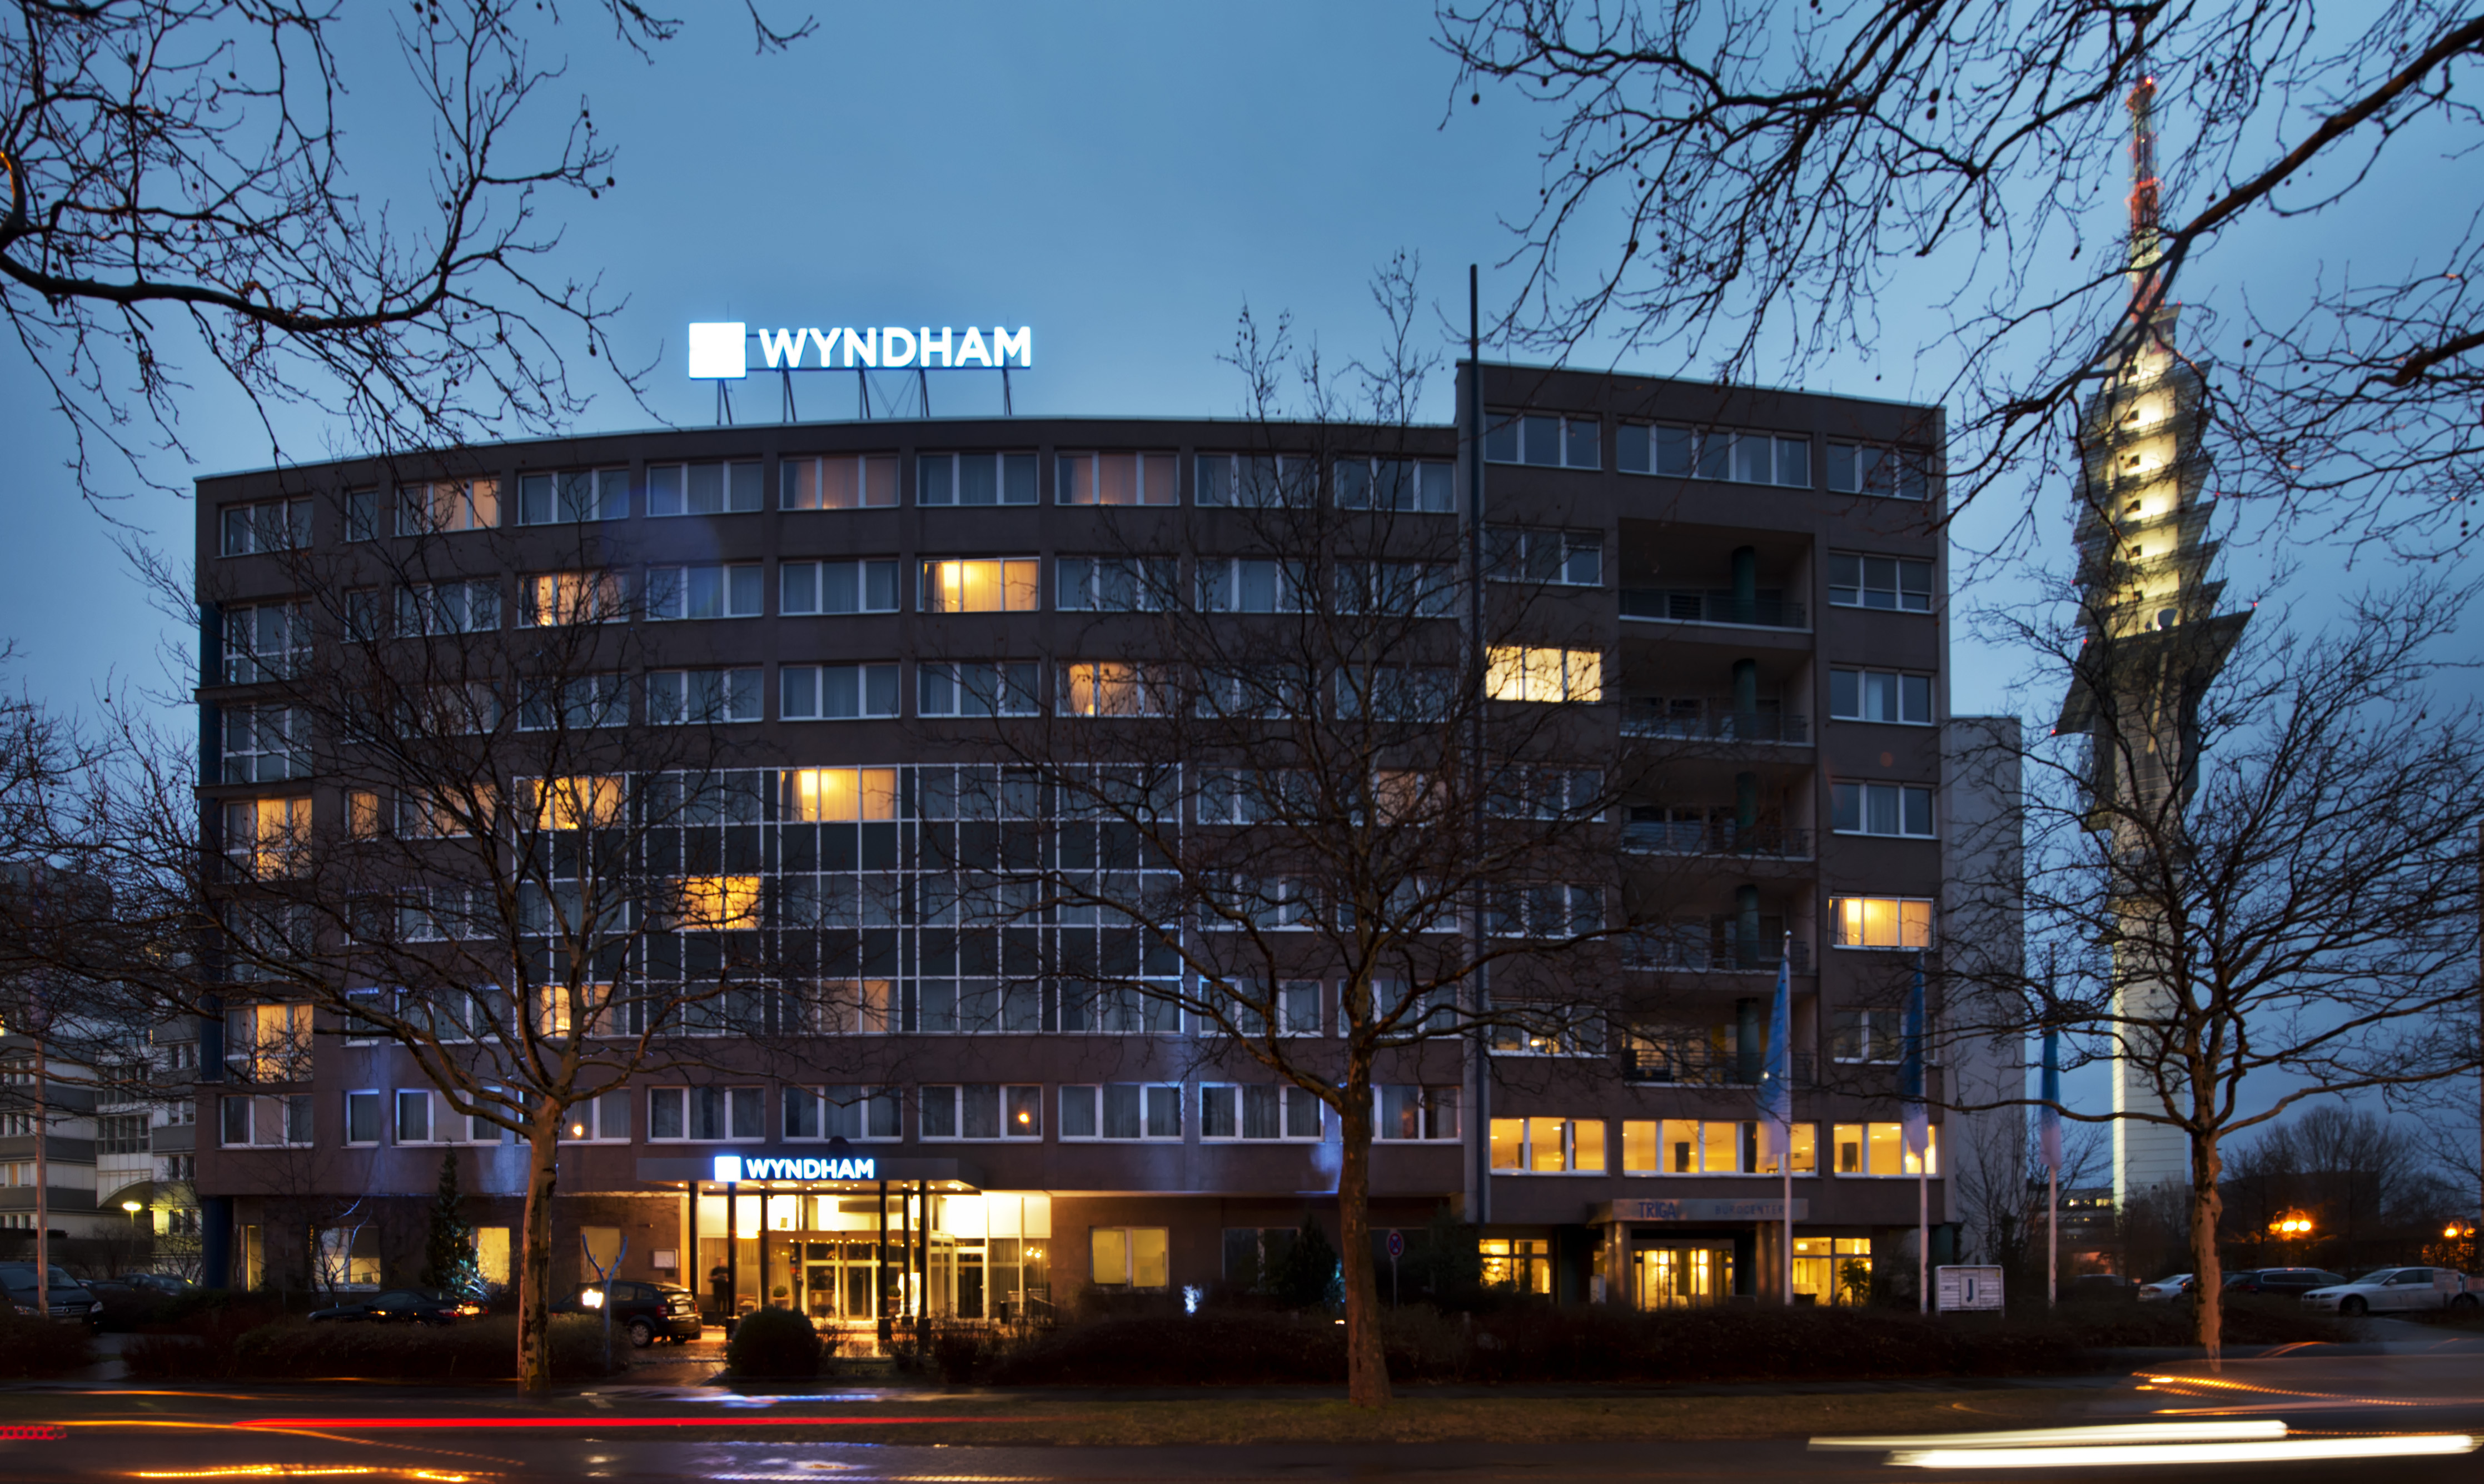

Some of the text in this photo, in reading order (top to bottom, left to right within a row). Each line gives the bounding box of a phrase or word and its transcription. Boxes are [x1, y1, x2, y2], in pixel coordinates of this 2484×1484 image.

[759, 326, 1031, 368] WYNDHAM
[746, 1158, 874, 1179] WYNDHAM
[1638, 1202, 1676, 1218] TRIGA
